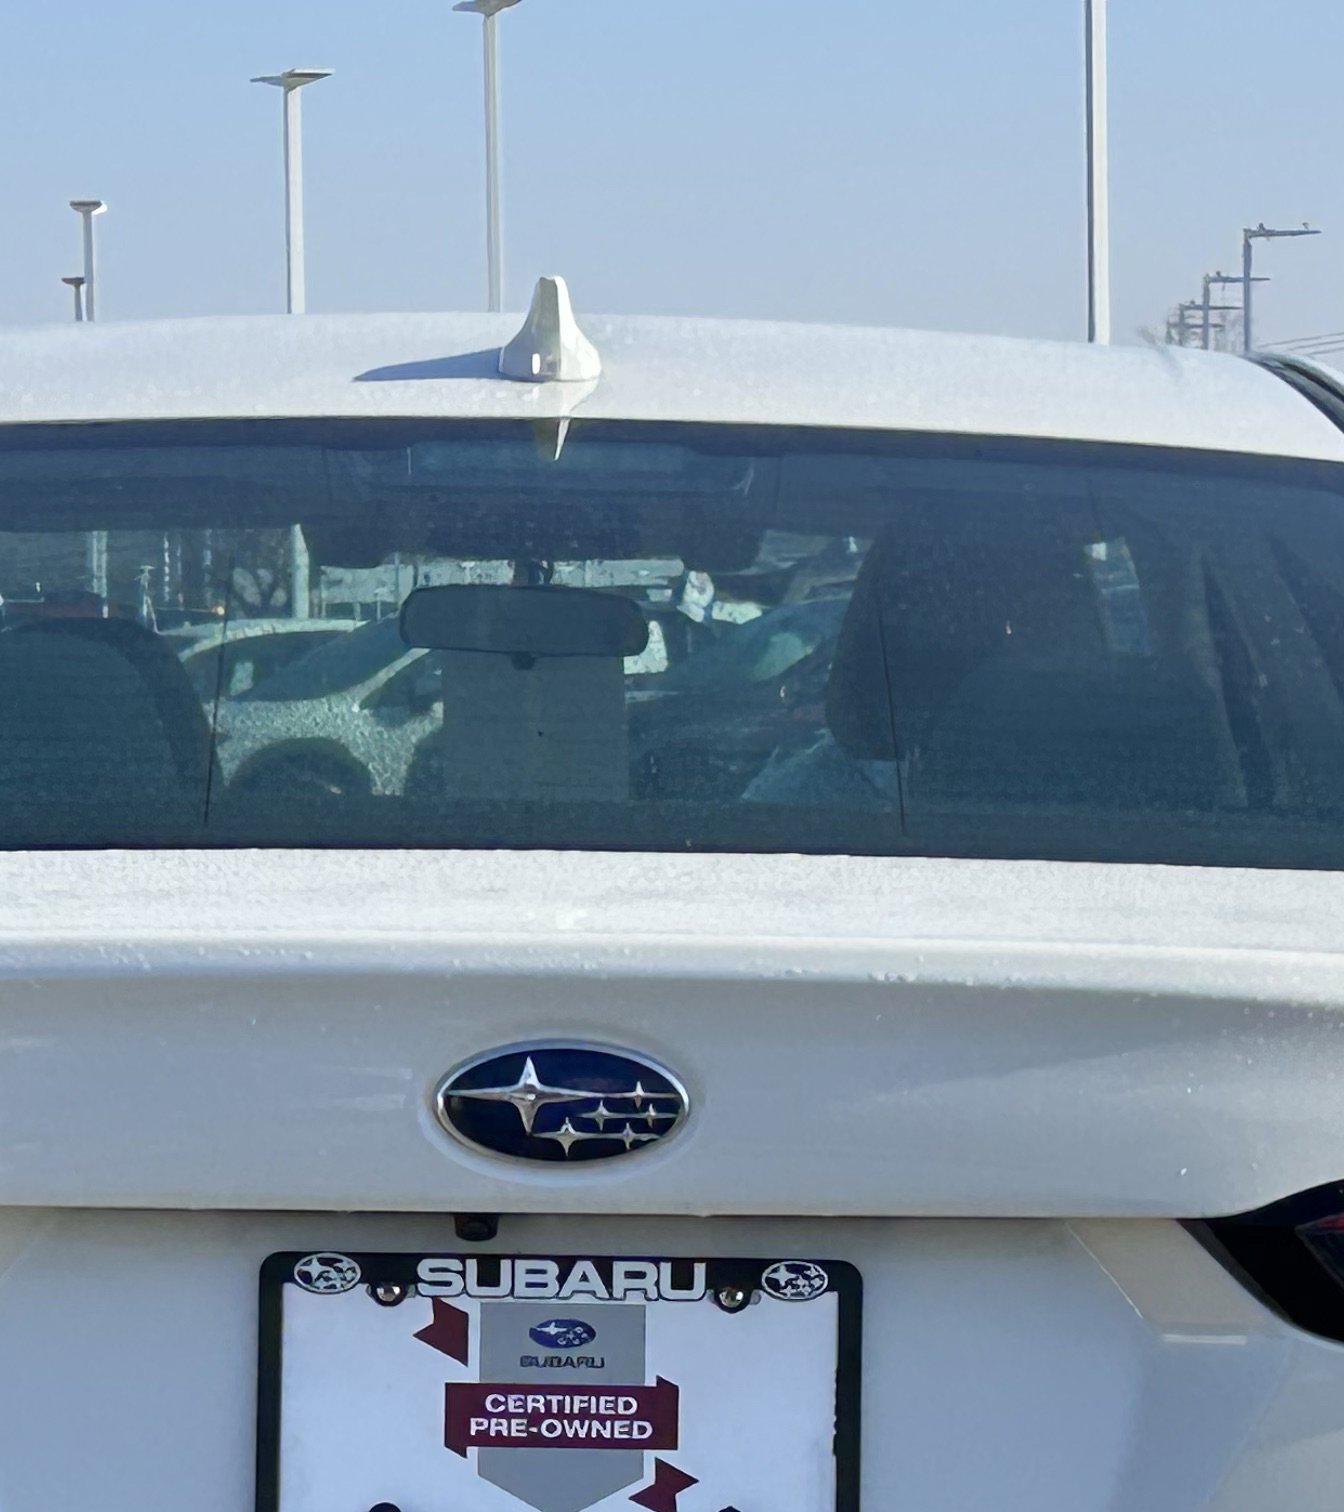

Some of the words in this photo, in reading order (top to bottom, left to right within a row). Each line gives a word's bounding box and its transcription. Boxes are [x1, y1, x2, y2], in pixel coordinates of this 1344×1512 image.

[416, 1257, 709, 1301] SUBARU
[484, 1393, 639, 1415] CERTIFIED
[469, 1417, 654, 1440] PRE-OWNED
